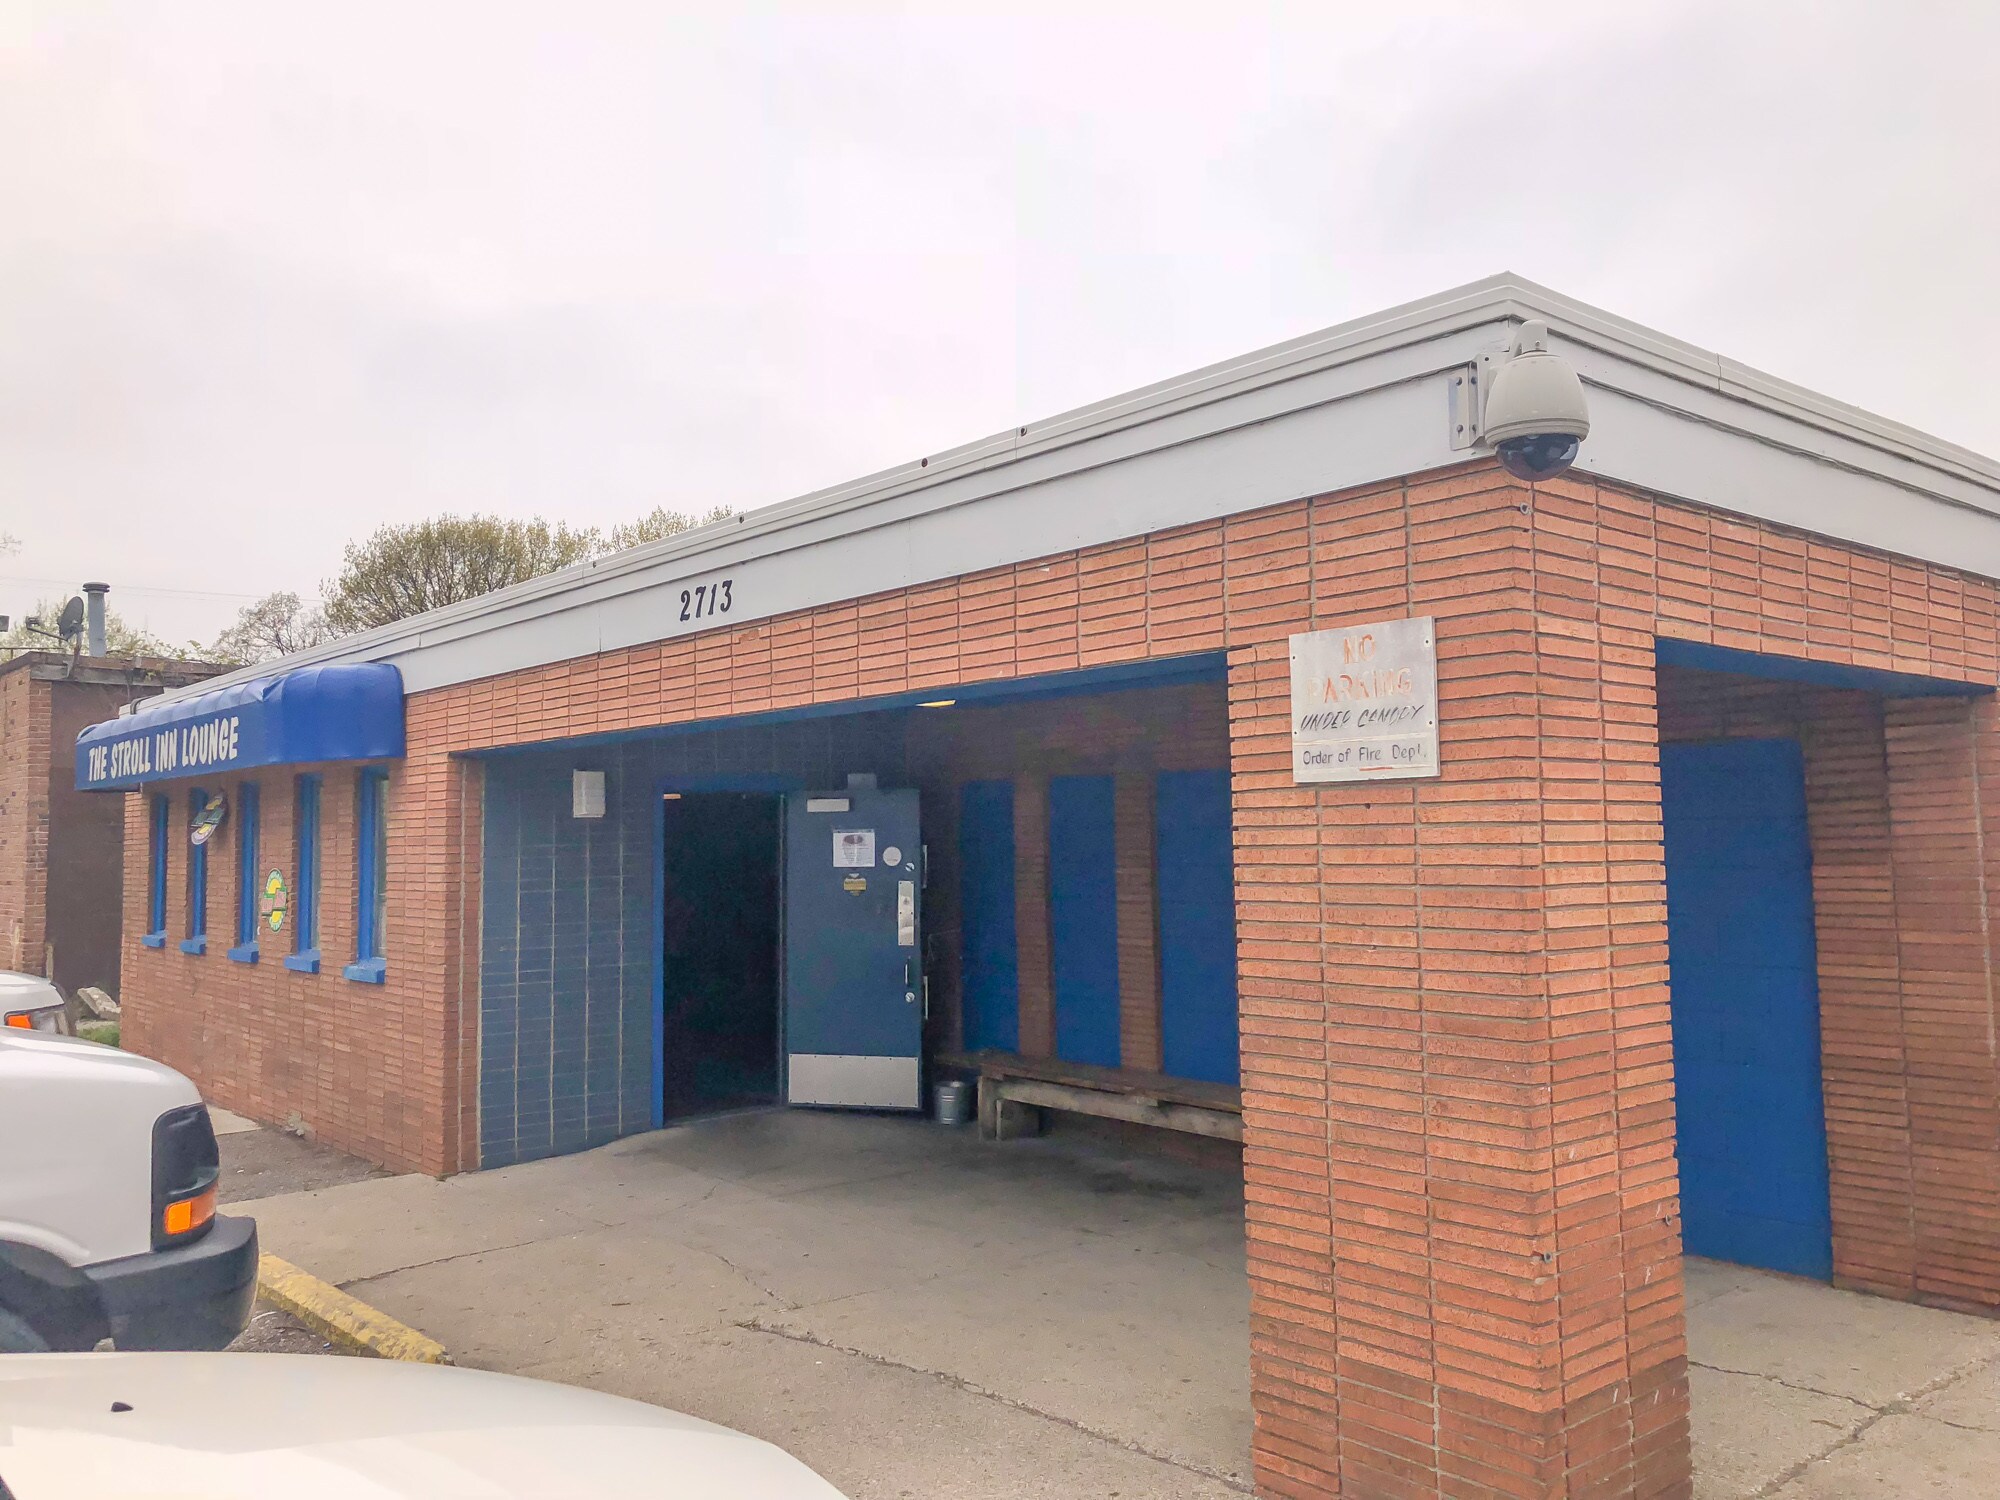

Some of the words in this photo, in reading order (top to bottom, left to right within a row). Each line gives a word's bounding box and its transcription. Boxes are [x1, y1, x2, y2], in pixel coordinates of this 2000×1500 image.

[679, 579, 733, 622] 2713
[1343, 634, 1376, 665] NO
[1308, 667, 1412, 704] PARKING
[88, 745, 108, 782] THE
[110, 736, 151, 779] STROLL
[155, 728, 178, 772] INN
[182, 716, 239, 767] LOUNGE
[1302, 750, 1334, 765] Order
[1338, 747, 1352, 762] of
[1358, 745, 1382, 761] Fire
